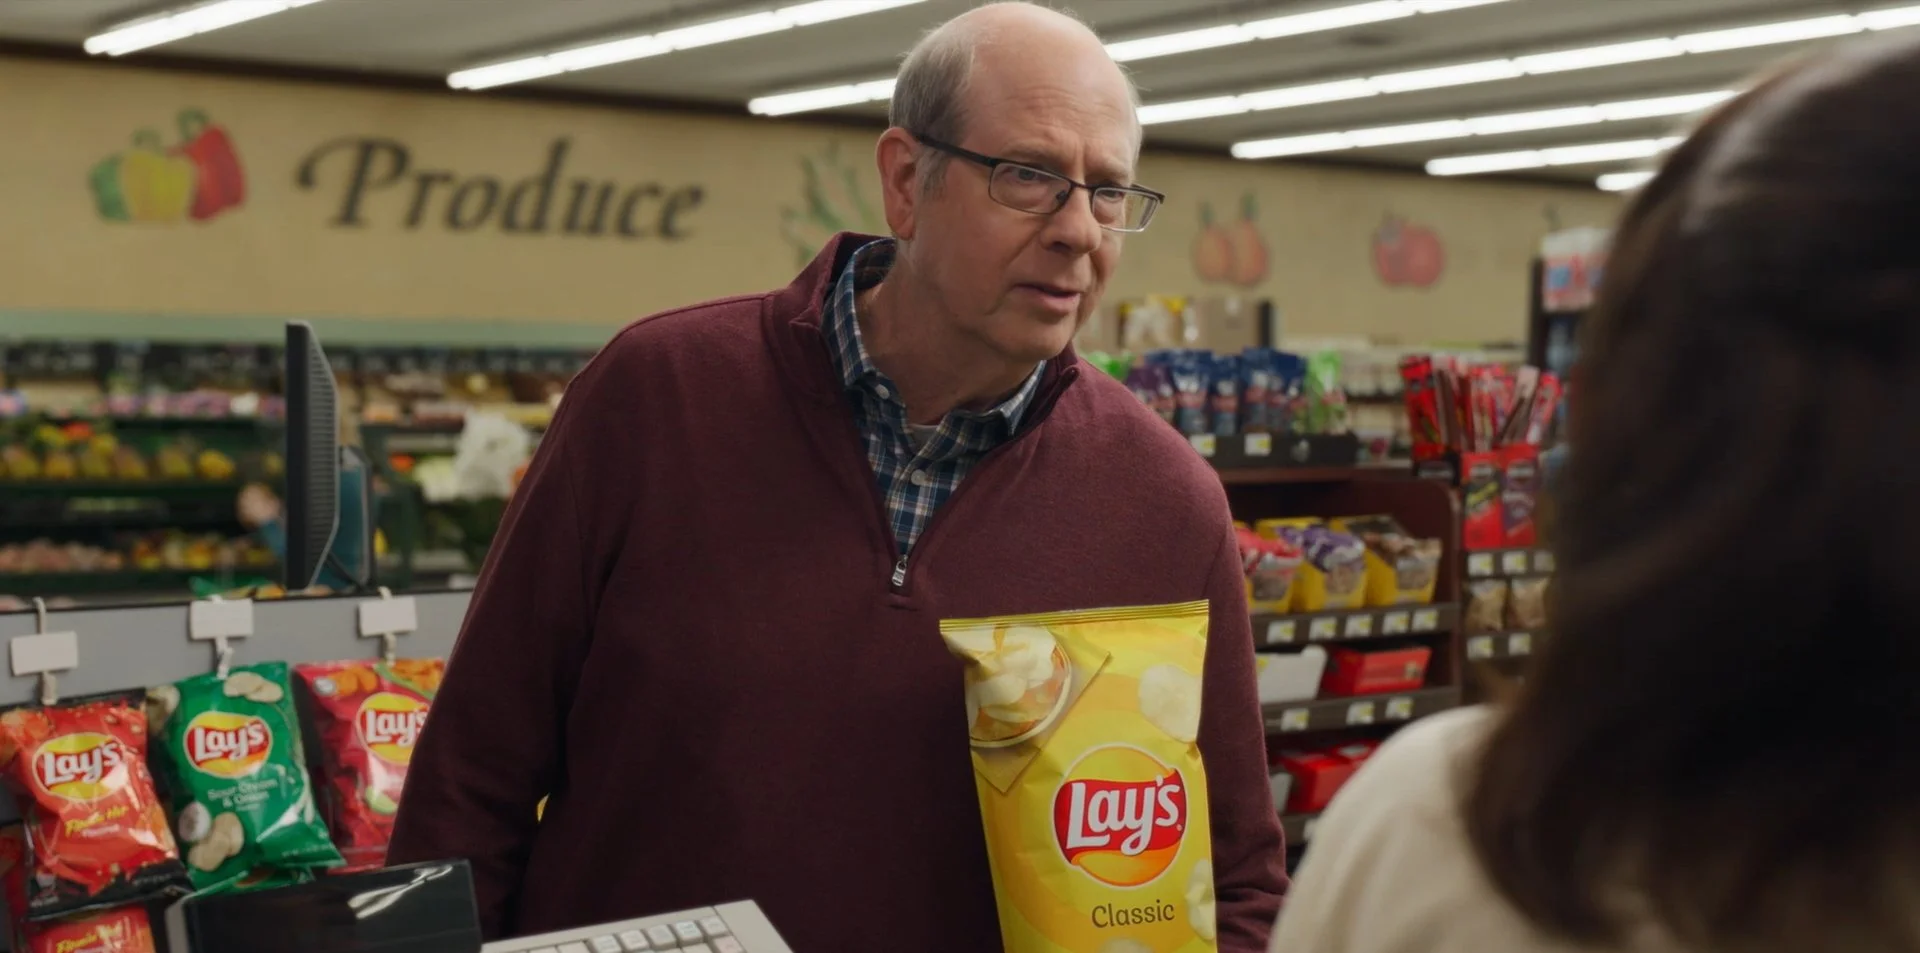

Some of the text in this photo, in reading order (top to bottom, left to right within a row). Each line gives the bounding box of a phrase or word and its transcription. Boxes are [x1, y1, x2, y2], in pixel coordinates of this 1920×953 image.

[295, 136, 706, 241] Produce
[42, 740, 122, 786] Lay's
[193, 719, 265, 762] Lay's
[1065, 774, 1183, 857] Lay's
[1091, 899, 1176, 929] Classic
